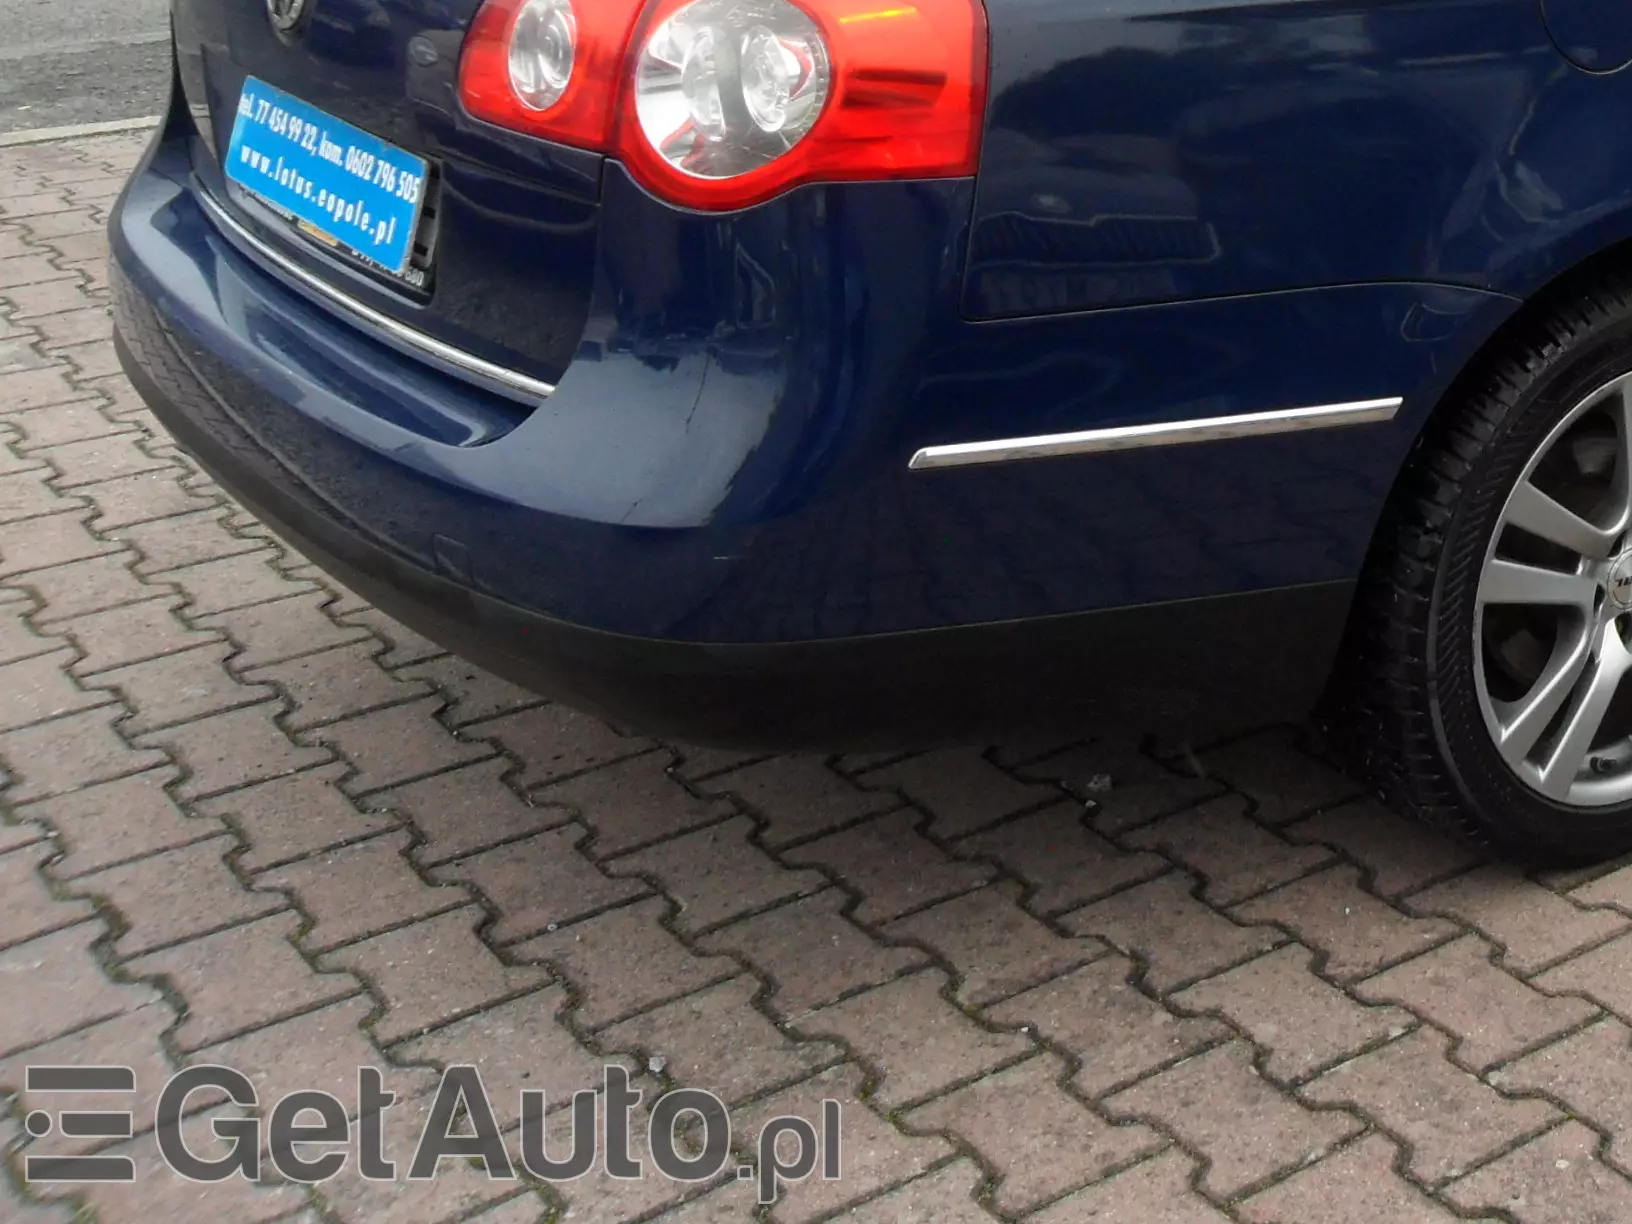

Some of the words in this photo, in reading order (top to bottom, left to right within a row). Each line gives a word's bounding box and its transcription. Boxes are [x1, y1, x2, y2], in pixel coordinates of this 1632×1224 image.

[240, 144, 397, 245] www.lotus.eopole.pl
[255, 99, 270, 125] 77
[268, 106, 287, 136] 454
[287, 116, 302, 143] 99
[319, 130, 343, 167] kom.
[344, 146, 375, 181] 0602
[373, 159, 398, 192] 796
[396, 171, 421, 203] 505
